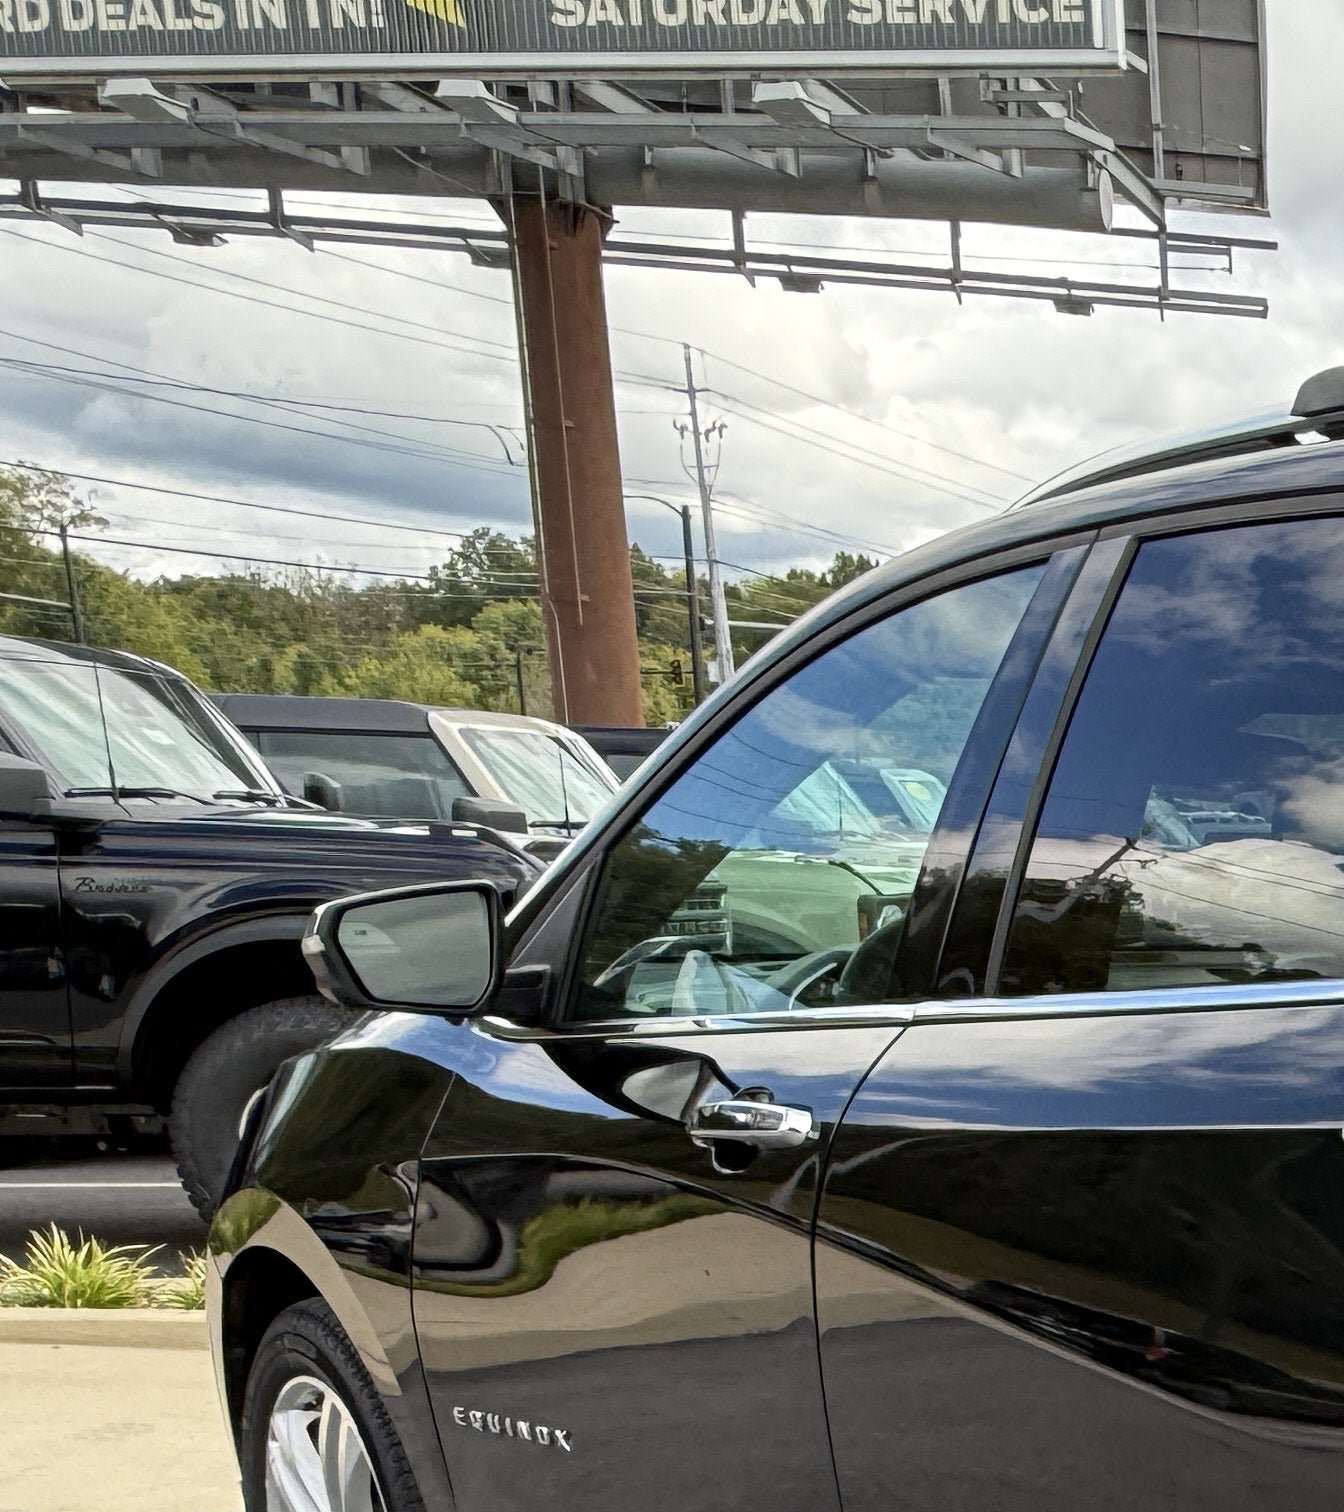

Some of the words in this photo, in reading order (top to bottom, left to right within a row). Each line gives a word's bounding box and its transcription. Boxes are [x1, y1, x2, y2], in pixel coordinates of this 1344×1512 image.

[61, 0, 226, 31] DEALS
[235, 0, 287, 30] IN
[551, 0, 827, 27] SATURDAY
[847, 0, 1084, 25] SERVICE
[453, 1406, 572, 1452] EQUINOX
